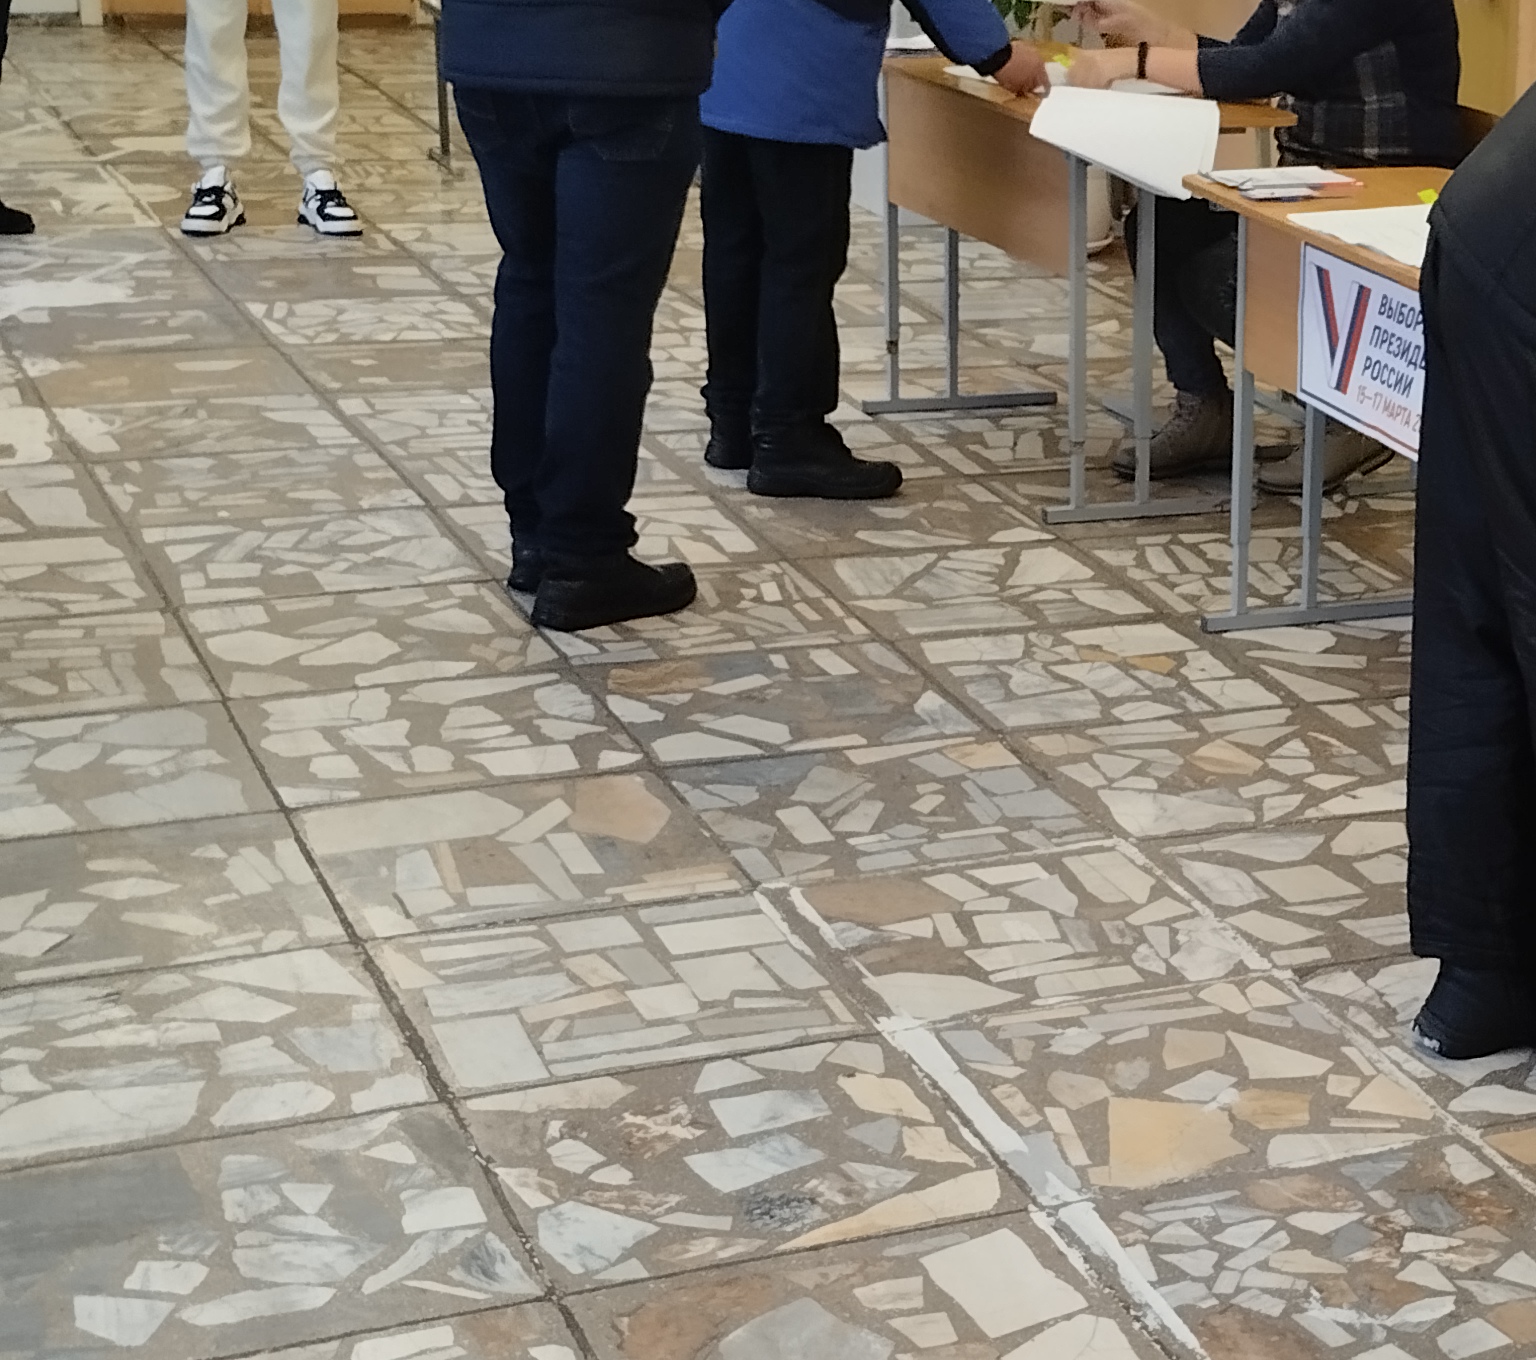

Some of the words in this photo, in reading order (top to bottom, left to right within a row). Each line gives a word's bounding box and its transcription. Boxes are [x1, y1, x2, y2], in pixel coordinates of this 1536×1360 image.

[1378, 293, 1424, 331] ВЫБОР
[1361, 355, 1414, 398] РОССИИ
[1380, 396, 1411, 427] МАРТА
